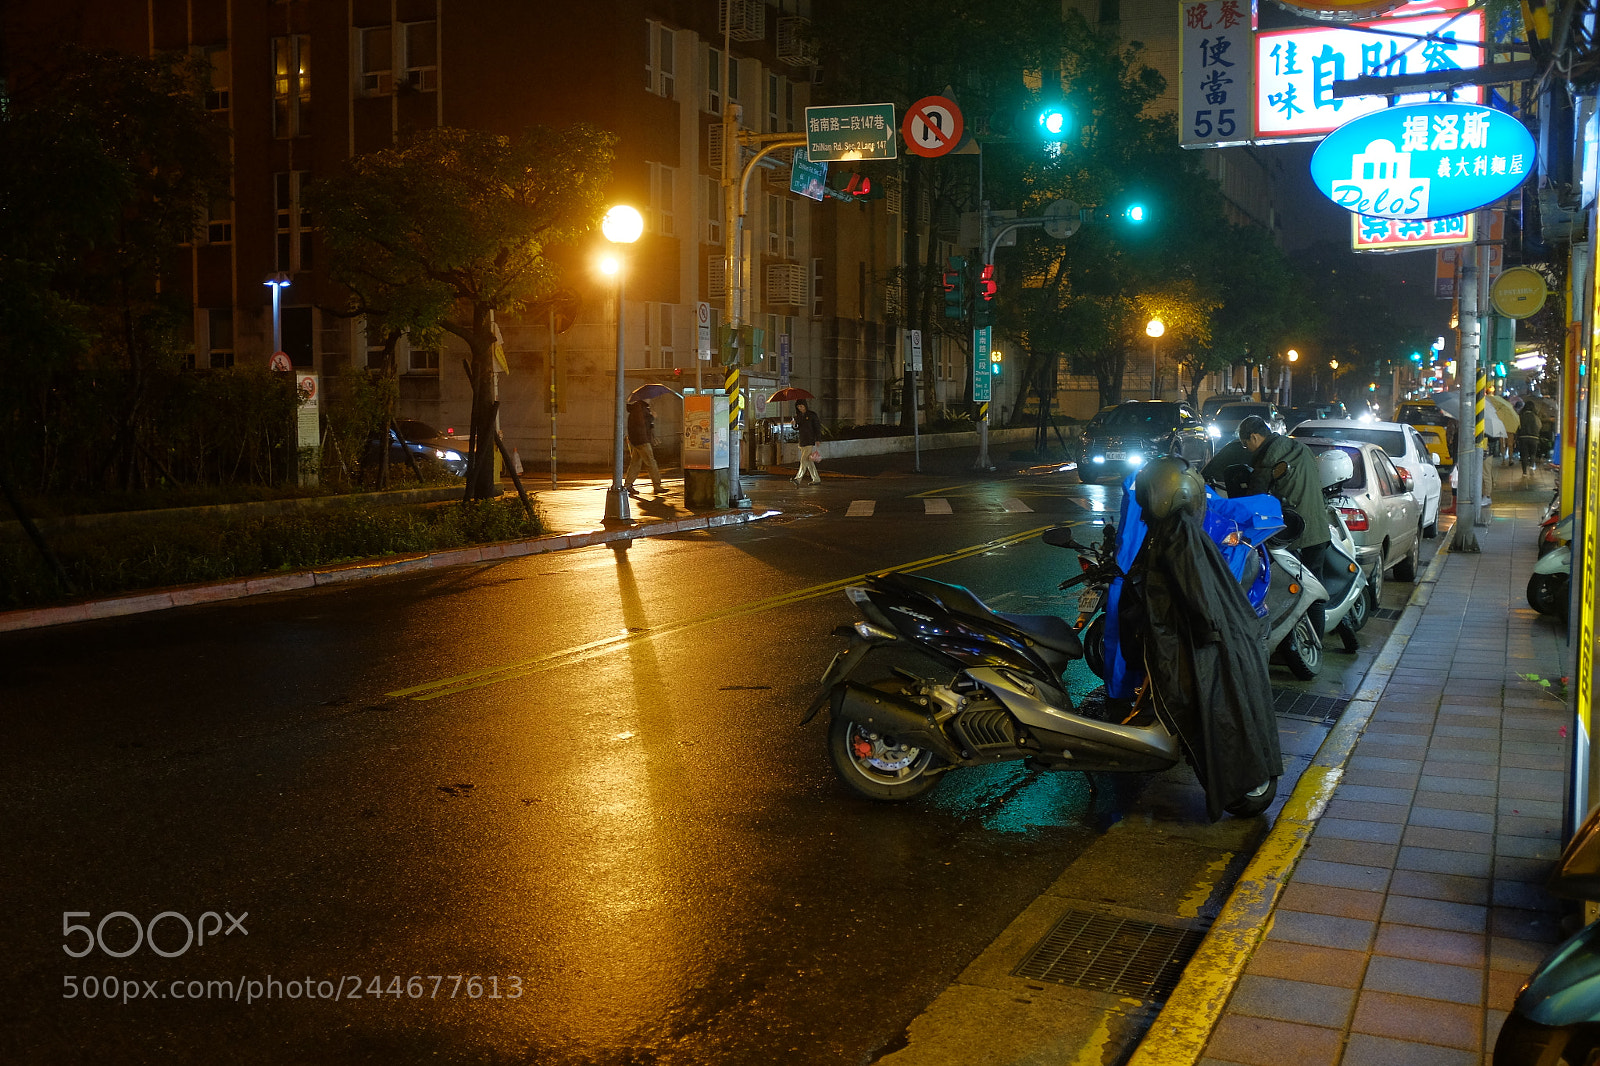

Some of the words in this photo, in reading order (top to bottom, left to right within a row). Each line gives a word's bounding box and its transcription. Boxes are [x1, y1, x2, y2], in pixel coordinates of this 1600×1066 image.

[1186, 1, 1245, 30] 晚餐
[1199, 35, 1235, 106] 便當
[1267, 40, 1305, 121] 佳味
[809, 114, 885, 133] 指南路二段147巷
[1194, 108, 1236, 138] 55
[1400, 110, 1491, 152] 提洛斯
